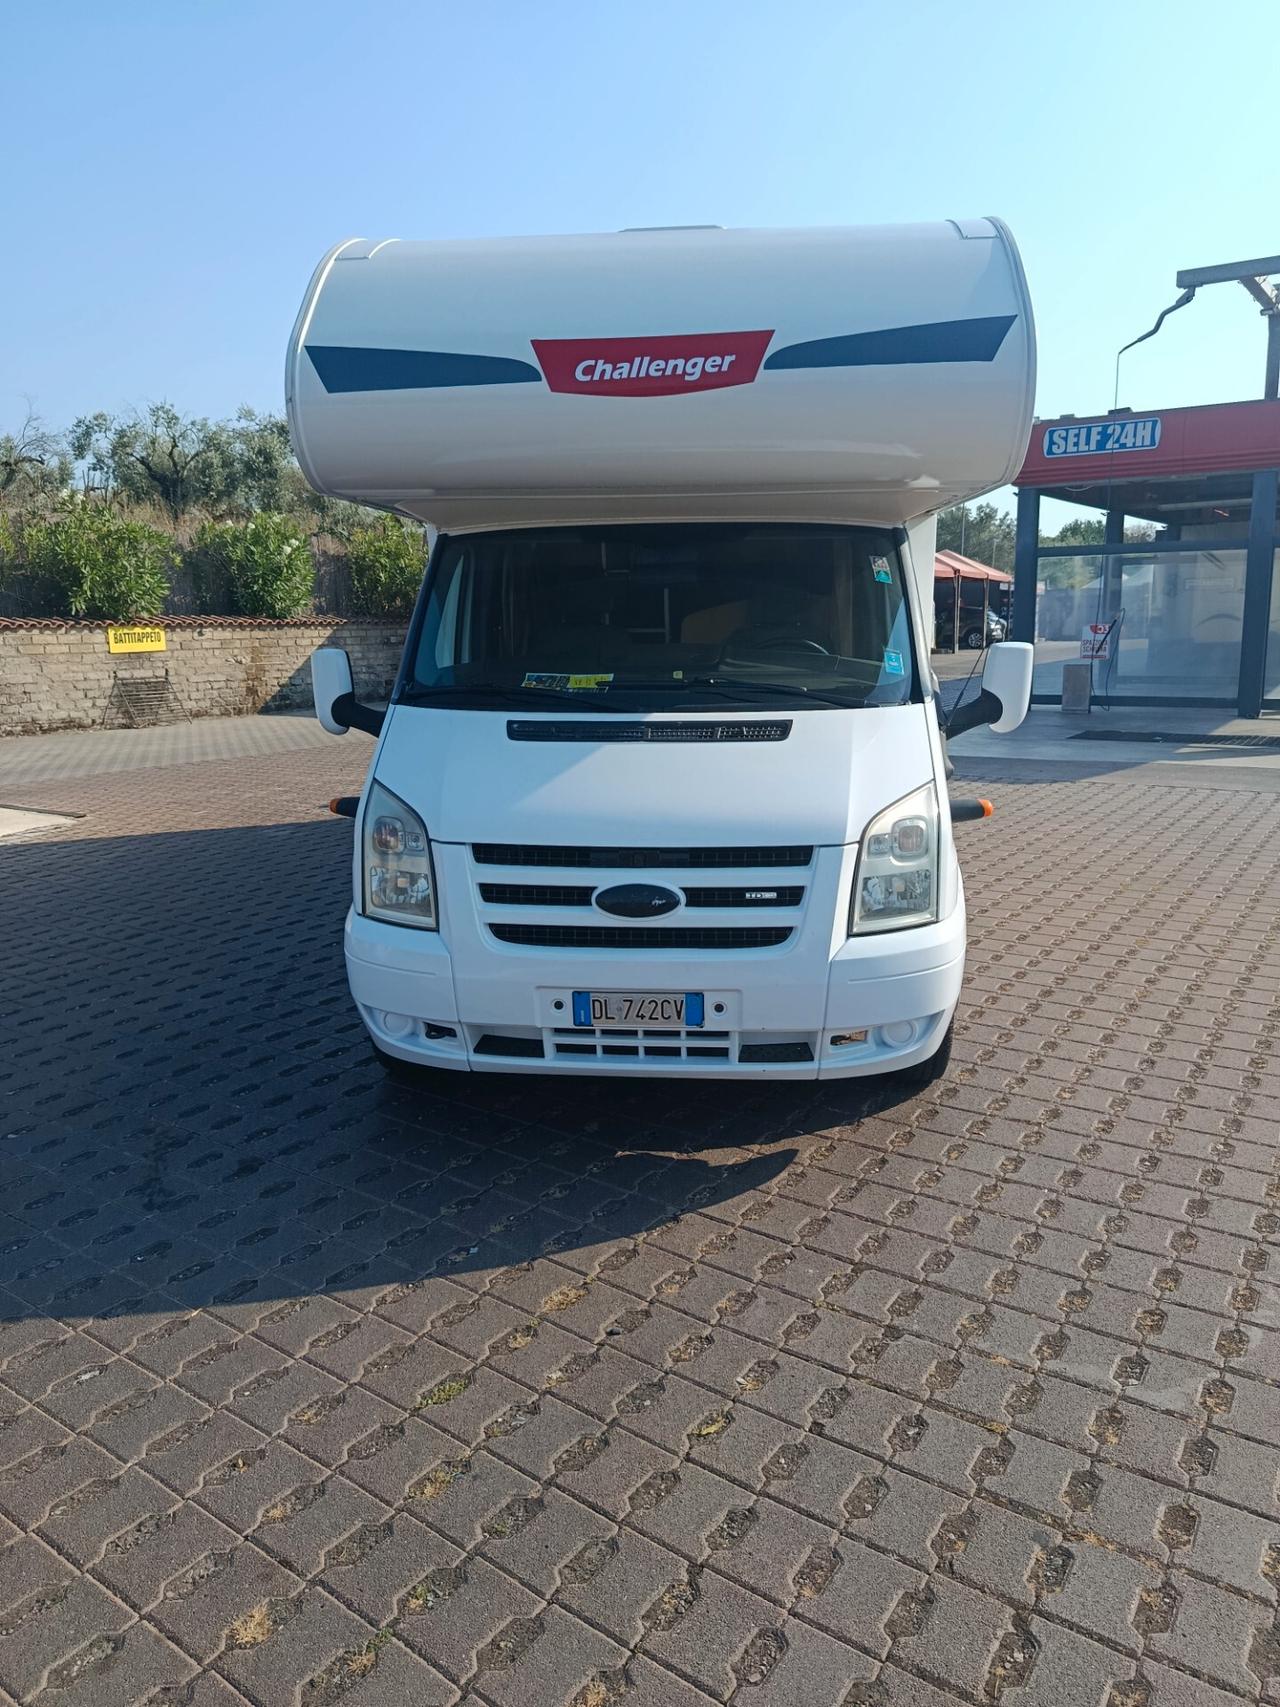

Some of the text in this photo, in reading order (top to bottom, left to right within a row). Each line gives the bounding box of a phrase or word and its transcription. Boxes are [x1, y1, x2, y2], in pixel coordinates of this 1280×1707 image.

[574, 354, 736, 382] Challenger
[1051, 421, 1153, 454] SELF 24H
[113, 631, 162, 644] BATTITAPPETO
[592, 999, 616, 1020] DL
[622, 999, 684, 1021] 742CV
